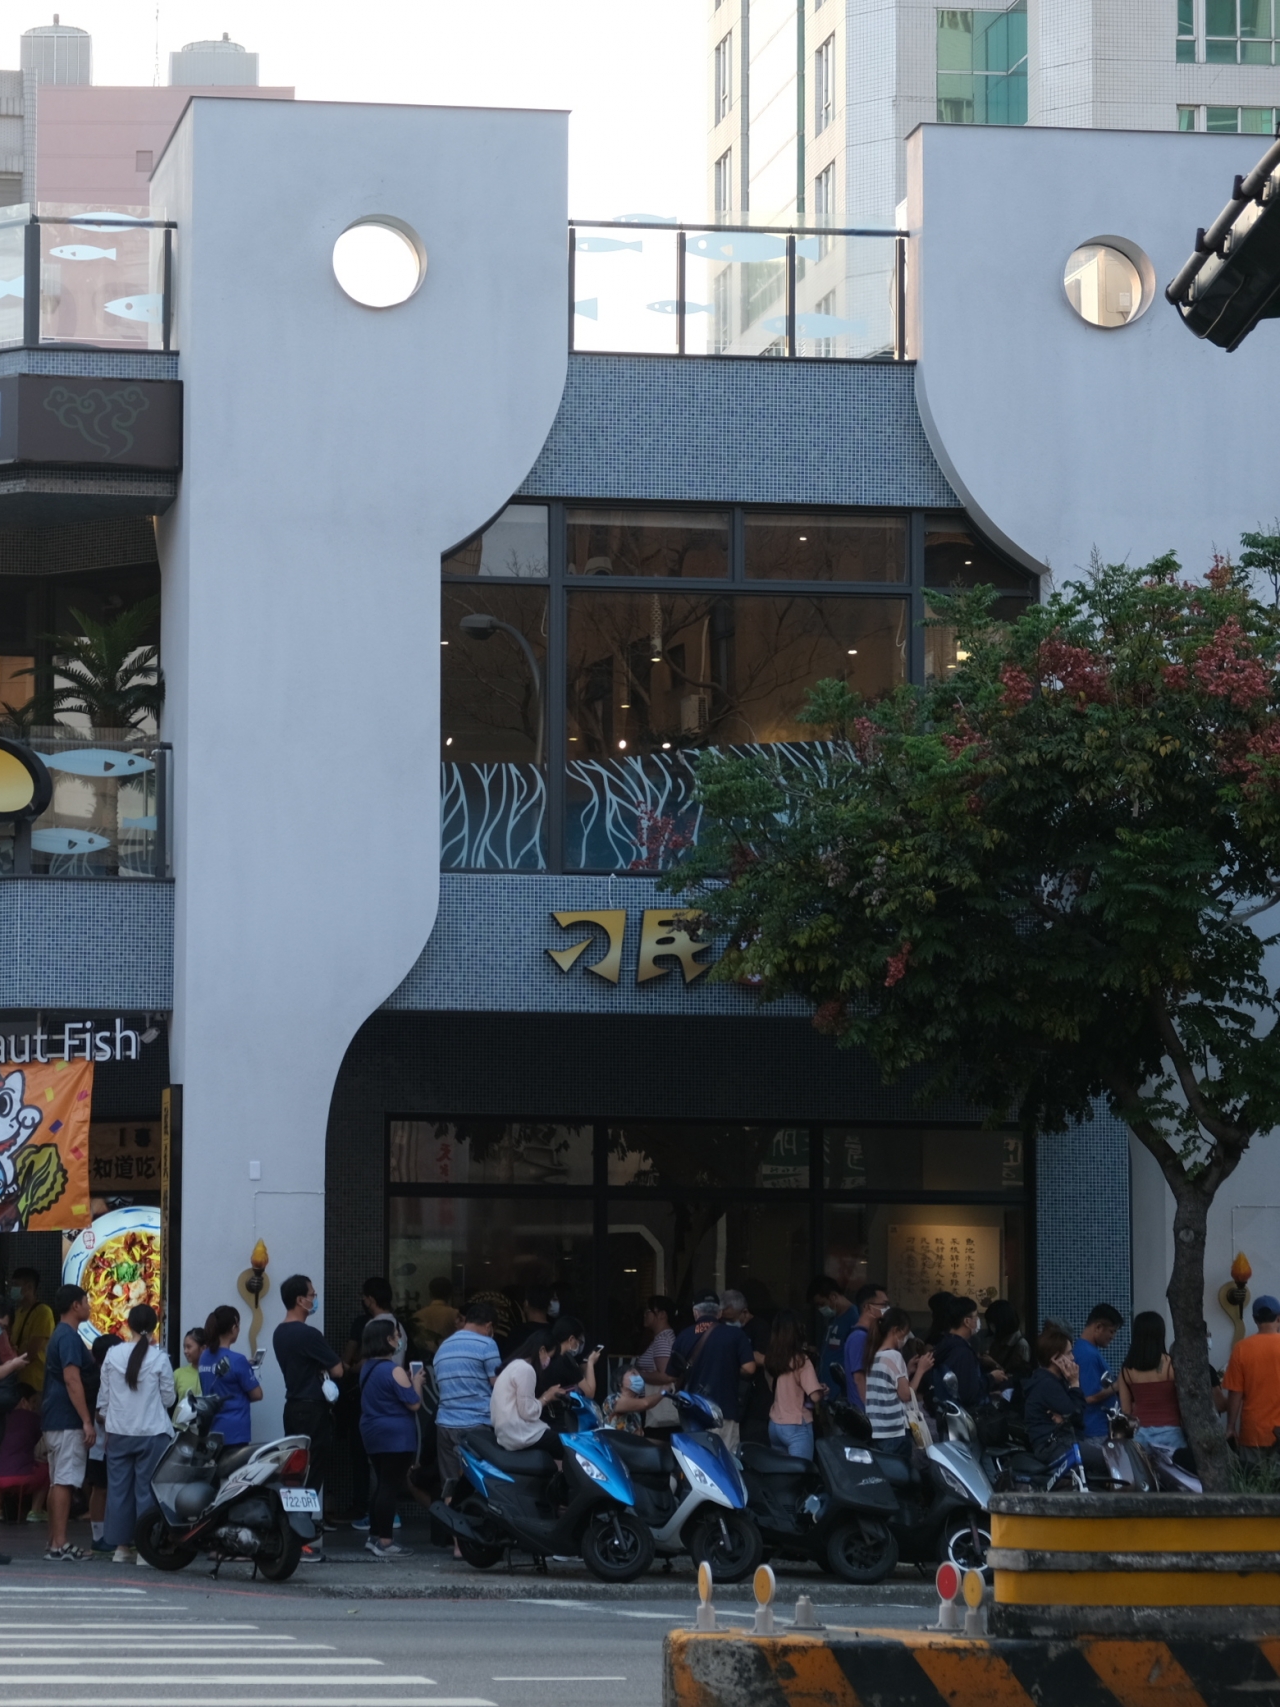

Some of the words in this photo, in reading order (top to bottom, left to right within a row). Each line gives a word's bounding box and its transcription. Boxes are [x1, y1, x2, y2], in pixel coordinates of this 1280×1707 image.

[546, 908, 713, 985] 刁民
[63, 1017, 140, 1062] Fish
[89, 1154, 161, 1180] 知道吃
